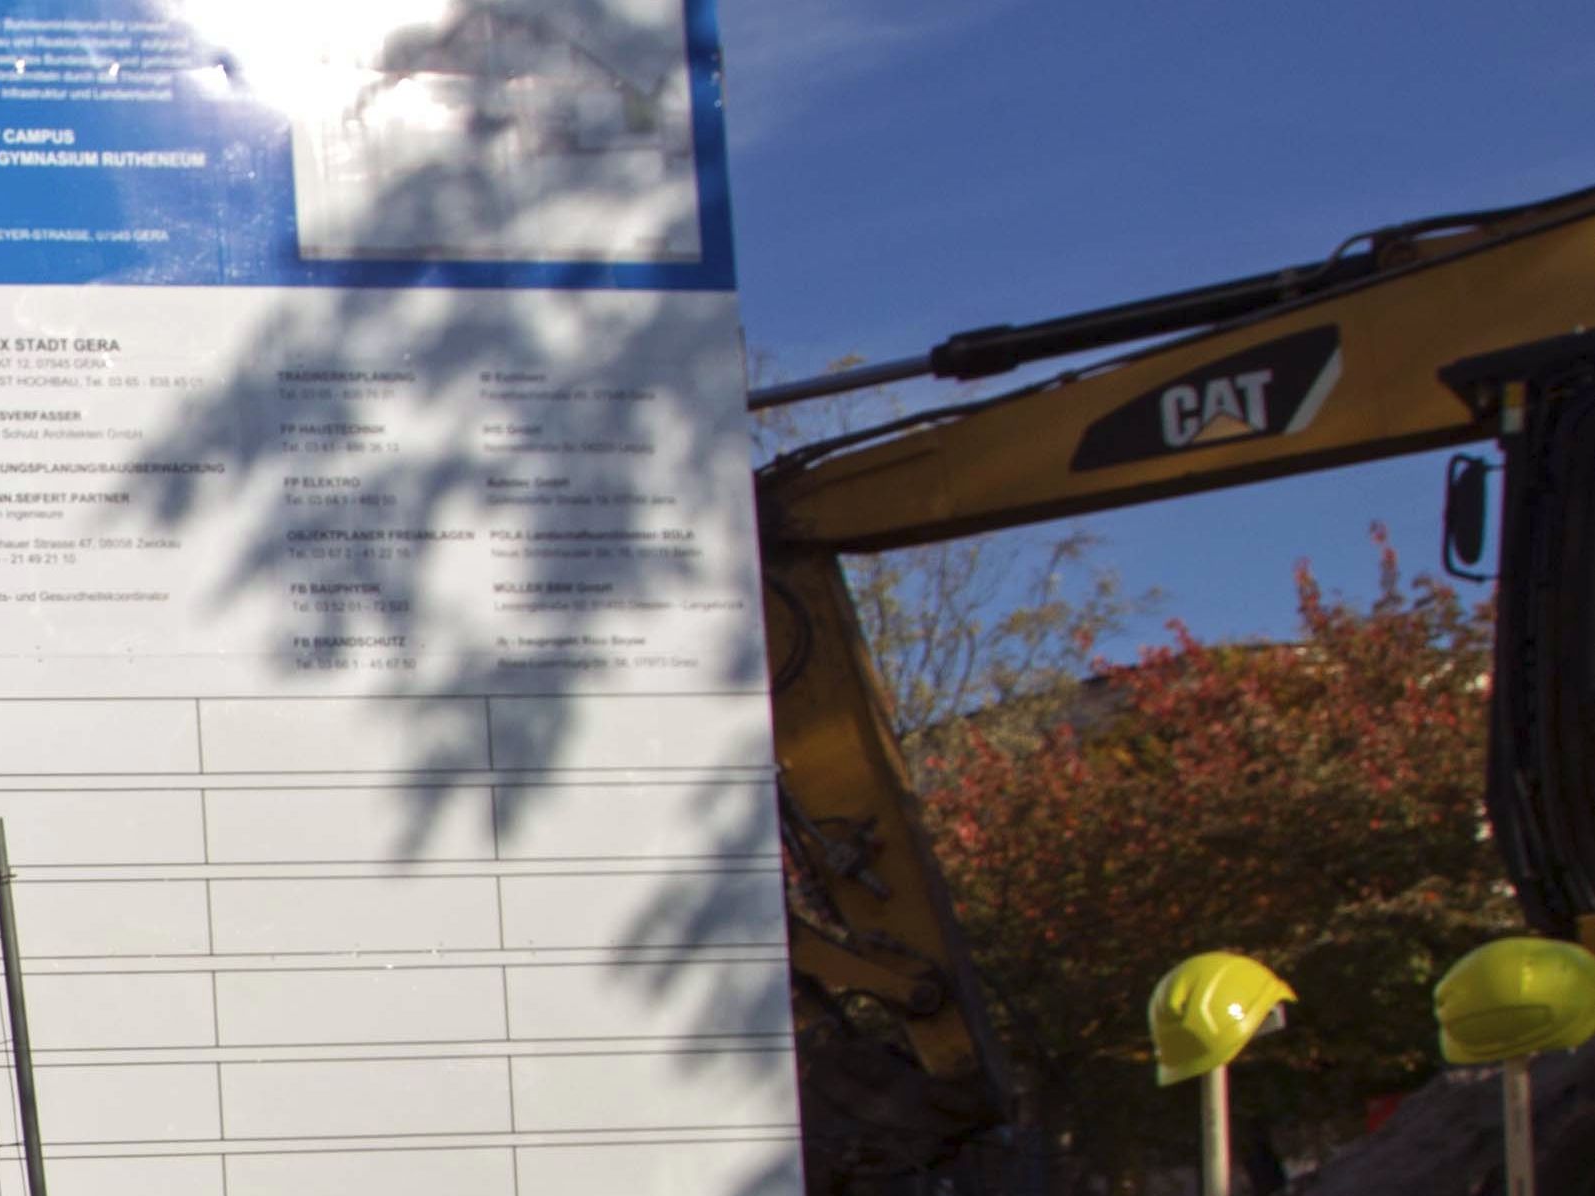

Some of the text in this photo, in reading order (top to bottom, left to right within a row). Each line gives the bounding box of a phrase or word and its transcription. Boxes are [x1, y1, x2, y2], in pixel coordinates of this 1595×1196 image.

[2, 128, 75, 145] CAMPUS
[101, 151, 206, 167] RUTHENEUM
[133, 229, 169, 241] GERA
[14, 338, 68, 352] STADT
[73, 338, 121, 352] GERA
[1161, 369, 1274, 448] CAT
[15, 592, 37, 602] und
